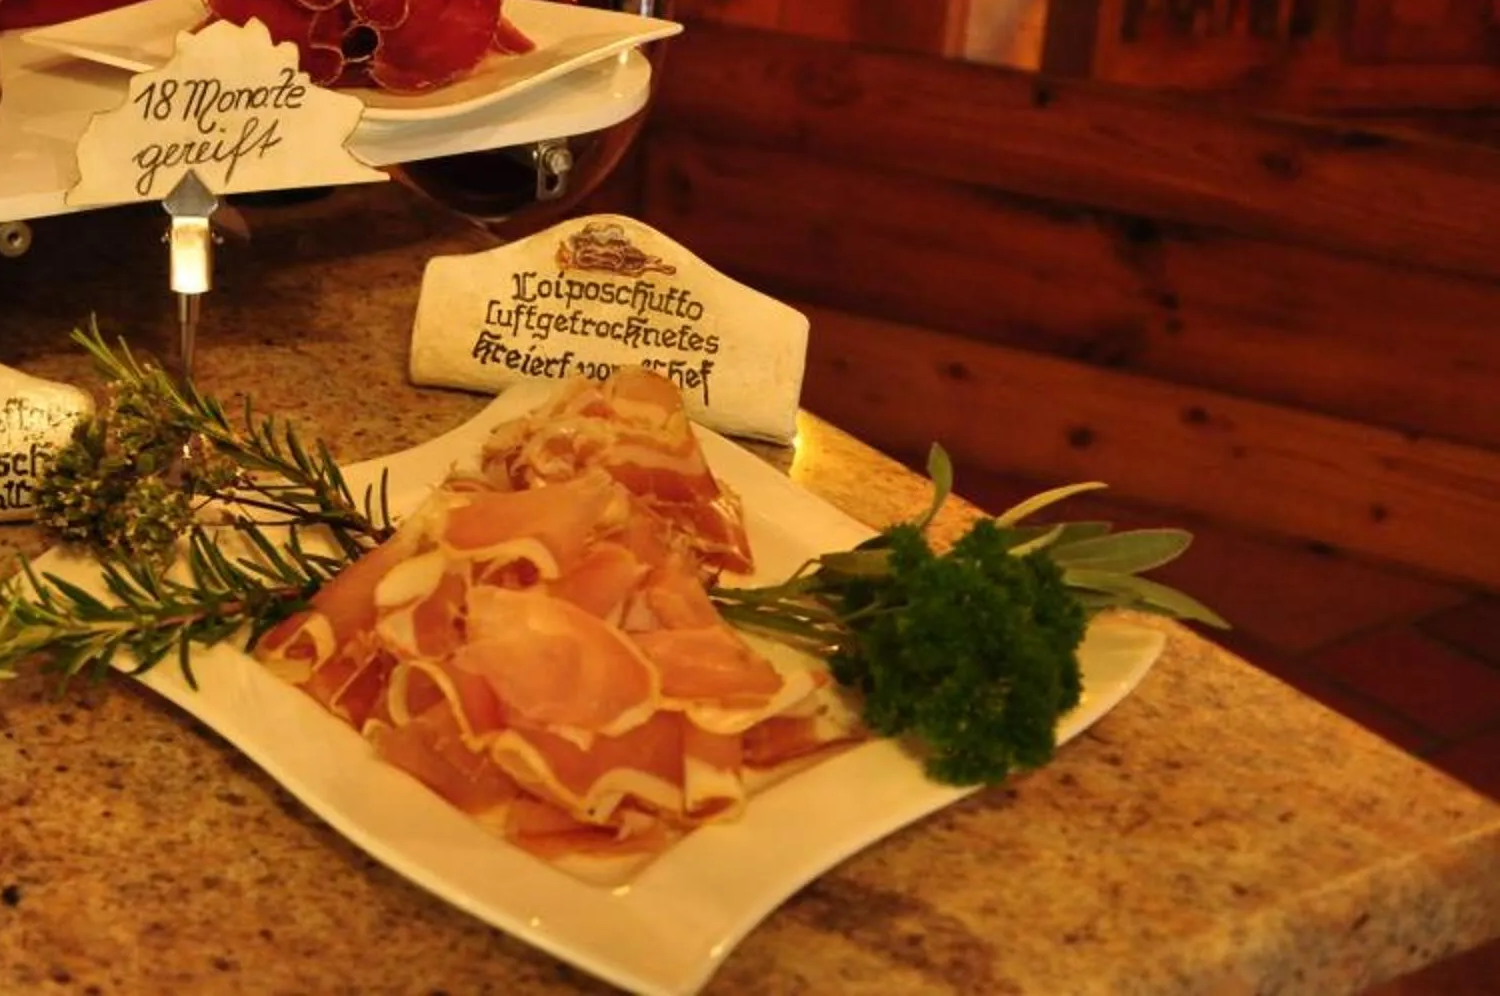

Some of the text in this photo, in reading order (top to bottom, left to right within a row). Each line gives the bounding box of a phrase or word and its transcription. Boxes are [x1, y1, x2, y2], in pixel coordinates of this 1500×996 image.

[134, 67, 308, 134] 18 Monate
[132, 118, 283, 196] gereift
[510, 271, 705, 323] Loiposchutto
[576, 360, 621, 382] vo
